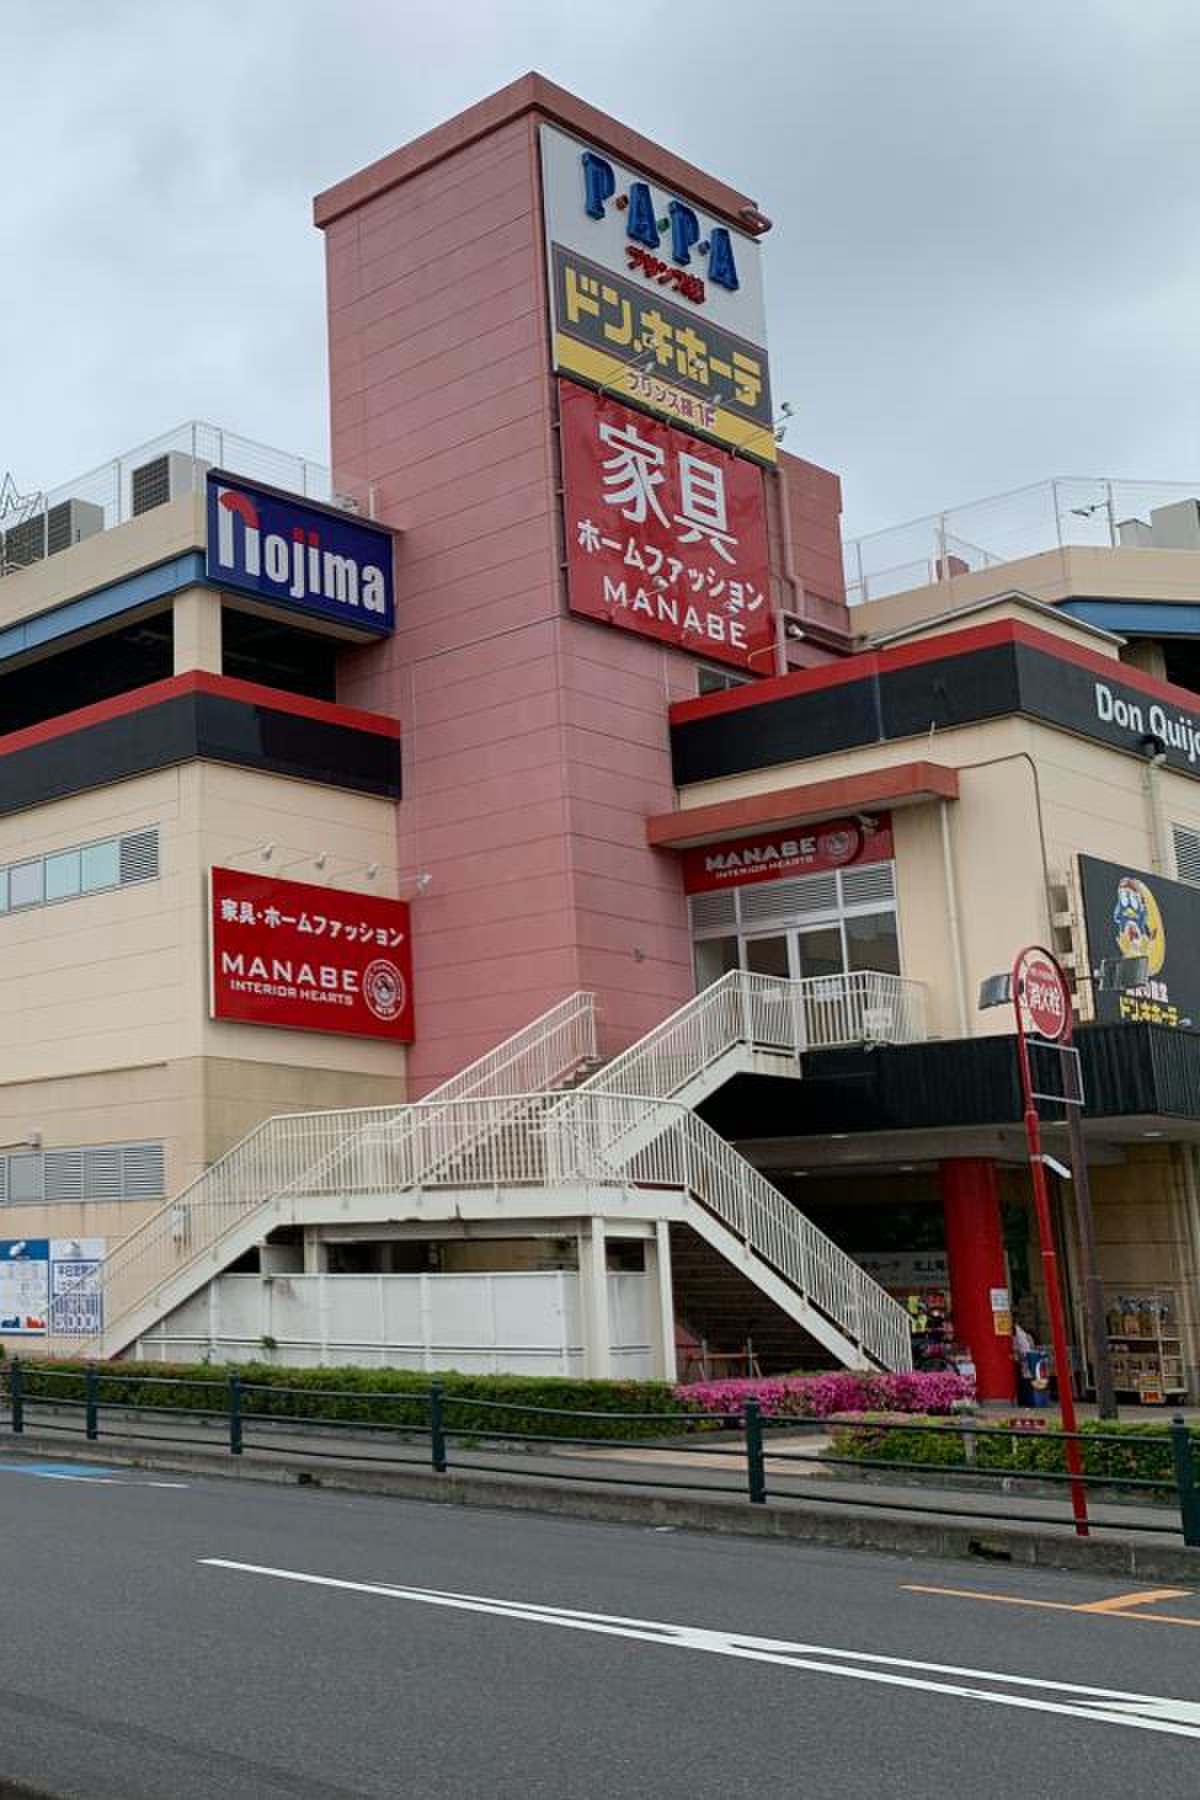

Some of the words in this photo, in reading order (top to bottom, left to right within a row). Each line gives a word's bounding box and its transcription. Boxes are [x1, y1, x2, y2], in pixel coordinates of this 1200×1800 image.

[599, 421, 739, 566] 家具
[576, 518, 764, 613] ホームファッション
[602, 575, 749, 650] MANABE
[1095, 682, 1144, 734] Don
[705, 836, 817, 872] MANABE
[220, 950, 360, 993] MANABE
[230, 978, 298, 999] INTERIOR
[300, 989, 354, 1006] HEARTS
